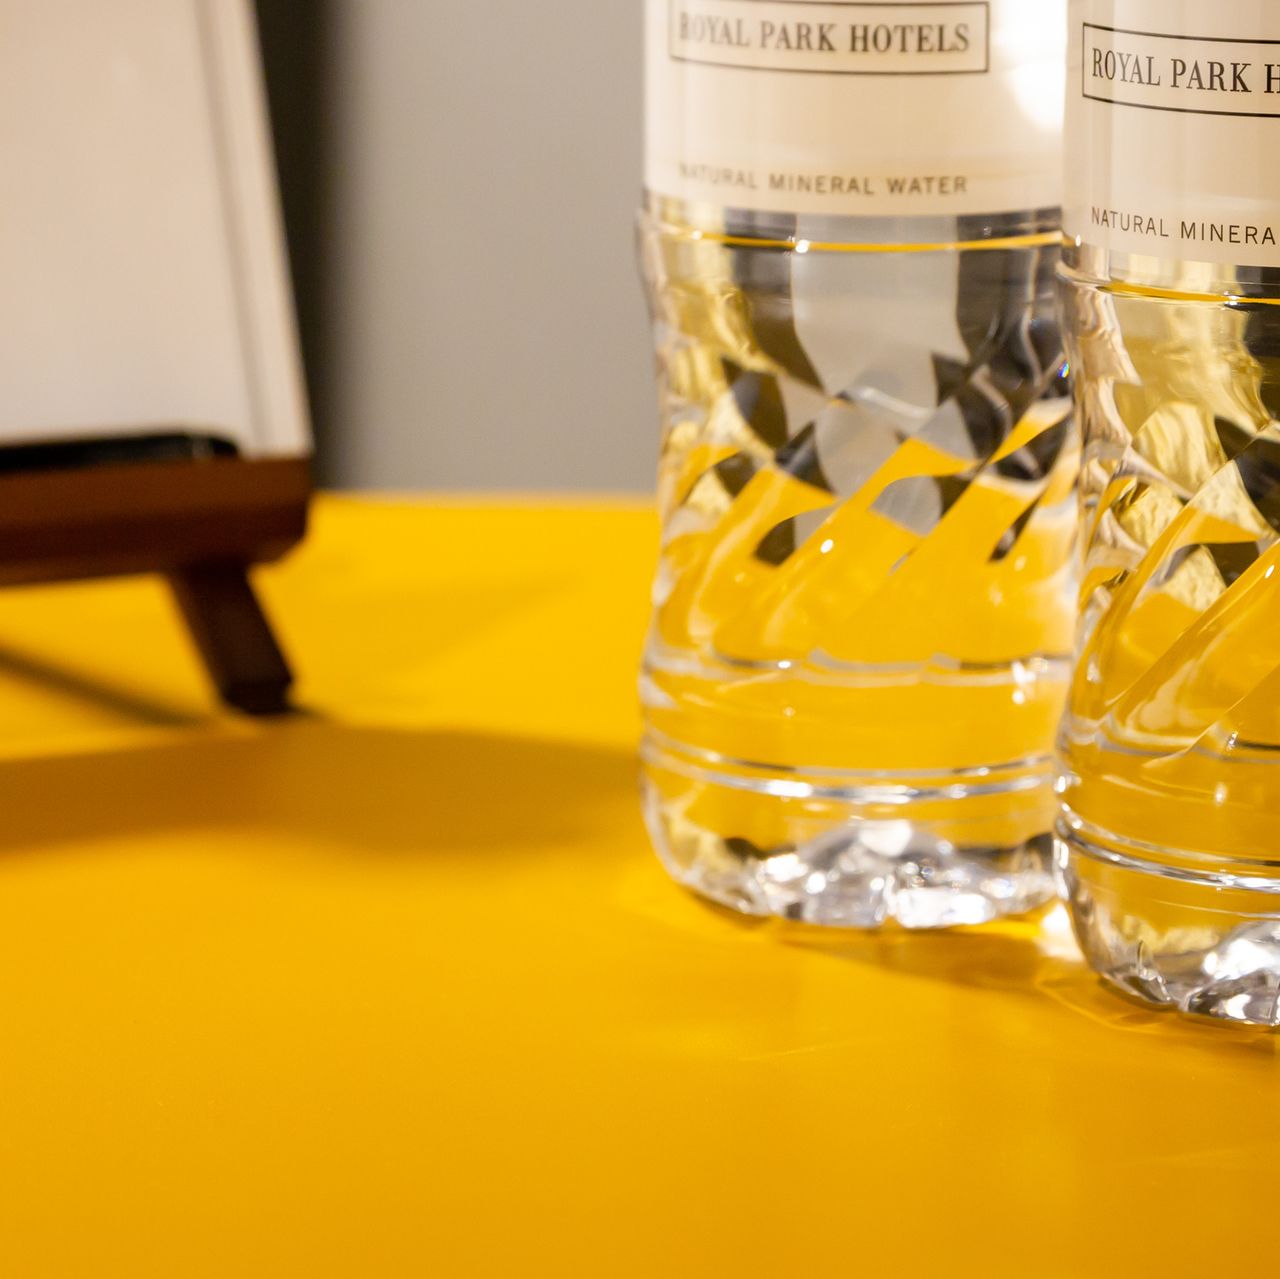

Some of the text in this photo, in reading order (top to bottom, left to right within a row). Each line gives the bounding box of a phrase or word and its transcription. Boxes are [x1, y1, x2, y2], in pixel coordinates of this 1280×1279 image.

[759, 21, 837, 53] PARK
[848, 23, 970, 54] HOTELS
[1091, 47, 1161, 87] ROYAL
[1170, 58, 1253, 94] PARK
[768, 172, 875, 195] MINERAL
[886, 175, 968, 196] WATER
[1090, 205, 1170, 238] NATURAL
